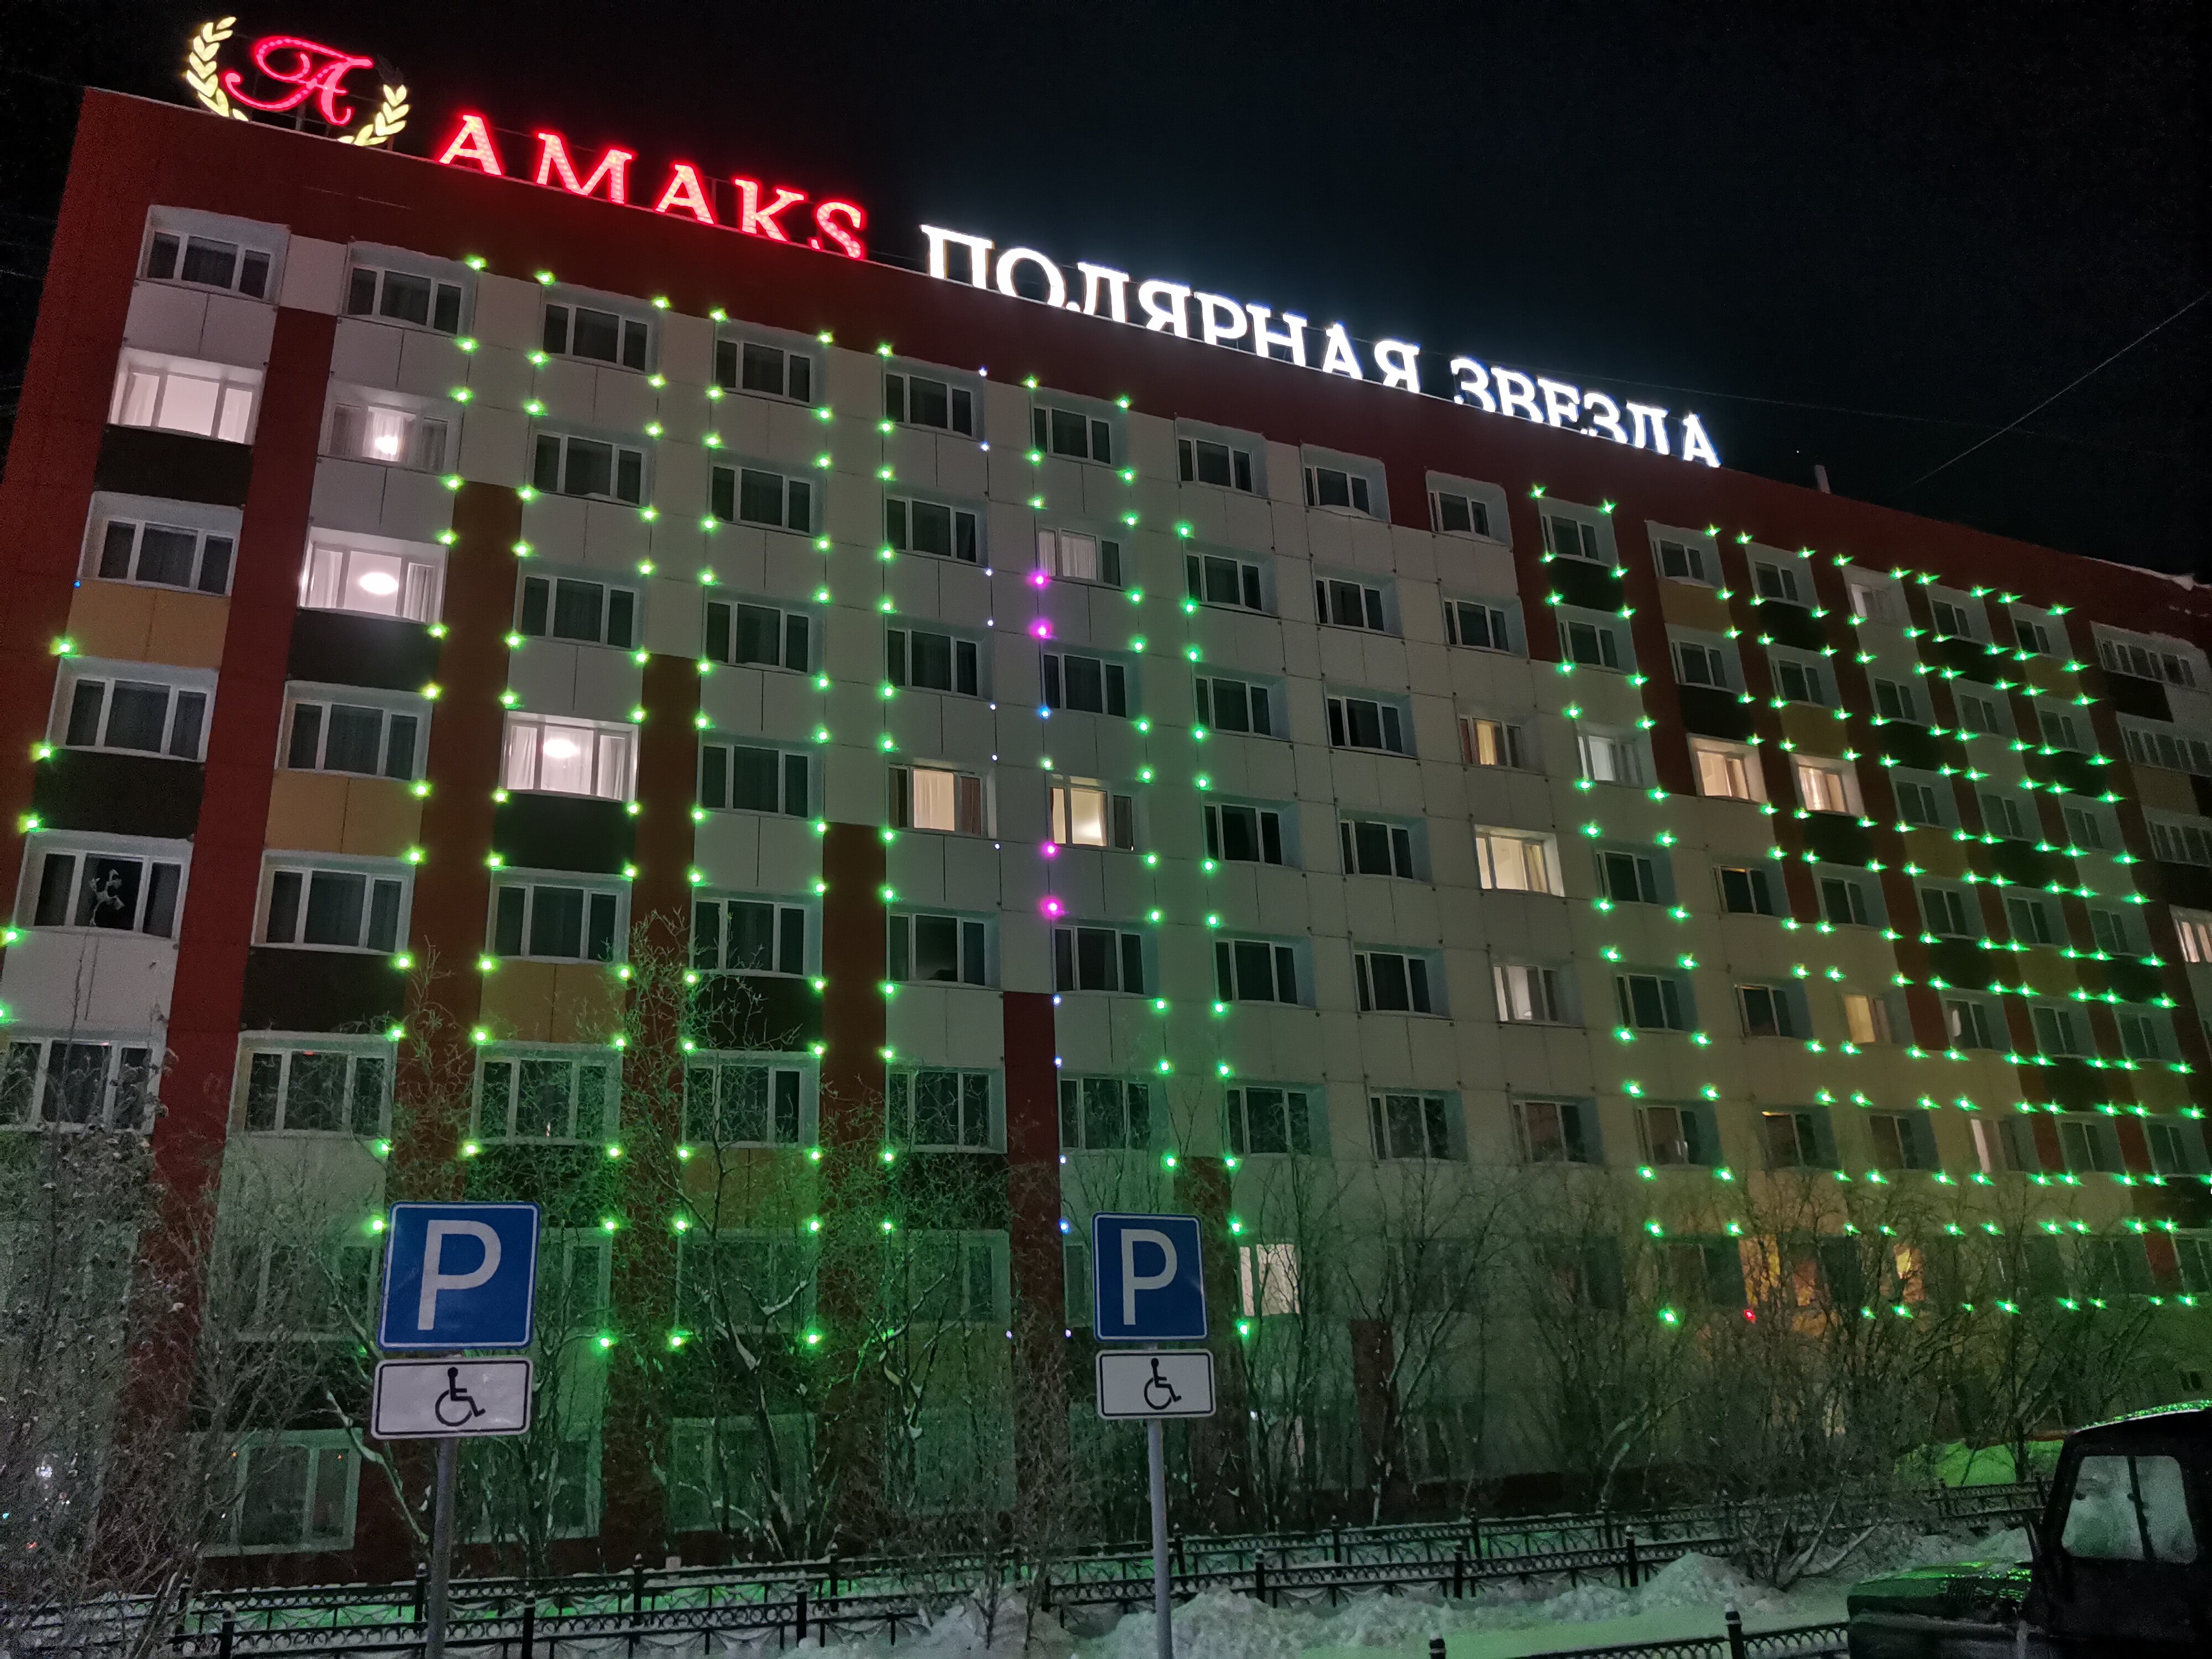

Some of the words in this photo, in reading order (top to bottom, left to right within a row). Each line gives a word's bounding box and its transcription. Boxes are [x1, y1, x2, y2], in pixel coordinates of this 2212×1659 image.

[439, 115, 864, 260] AMAKS
[921, 224, 1421, 394] ПОЛЯРНАЯ
[1450, 357, 1721, 468] ЗВЕЗДА
[418, 1220, 502, 1331] P
[1121, 1229, 1177, 1326] P
